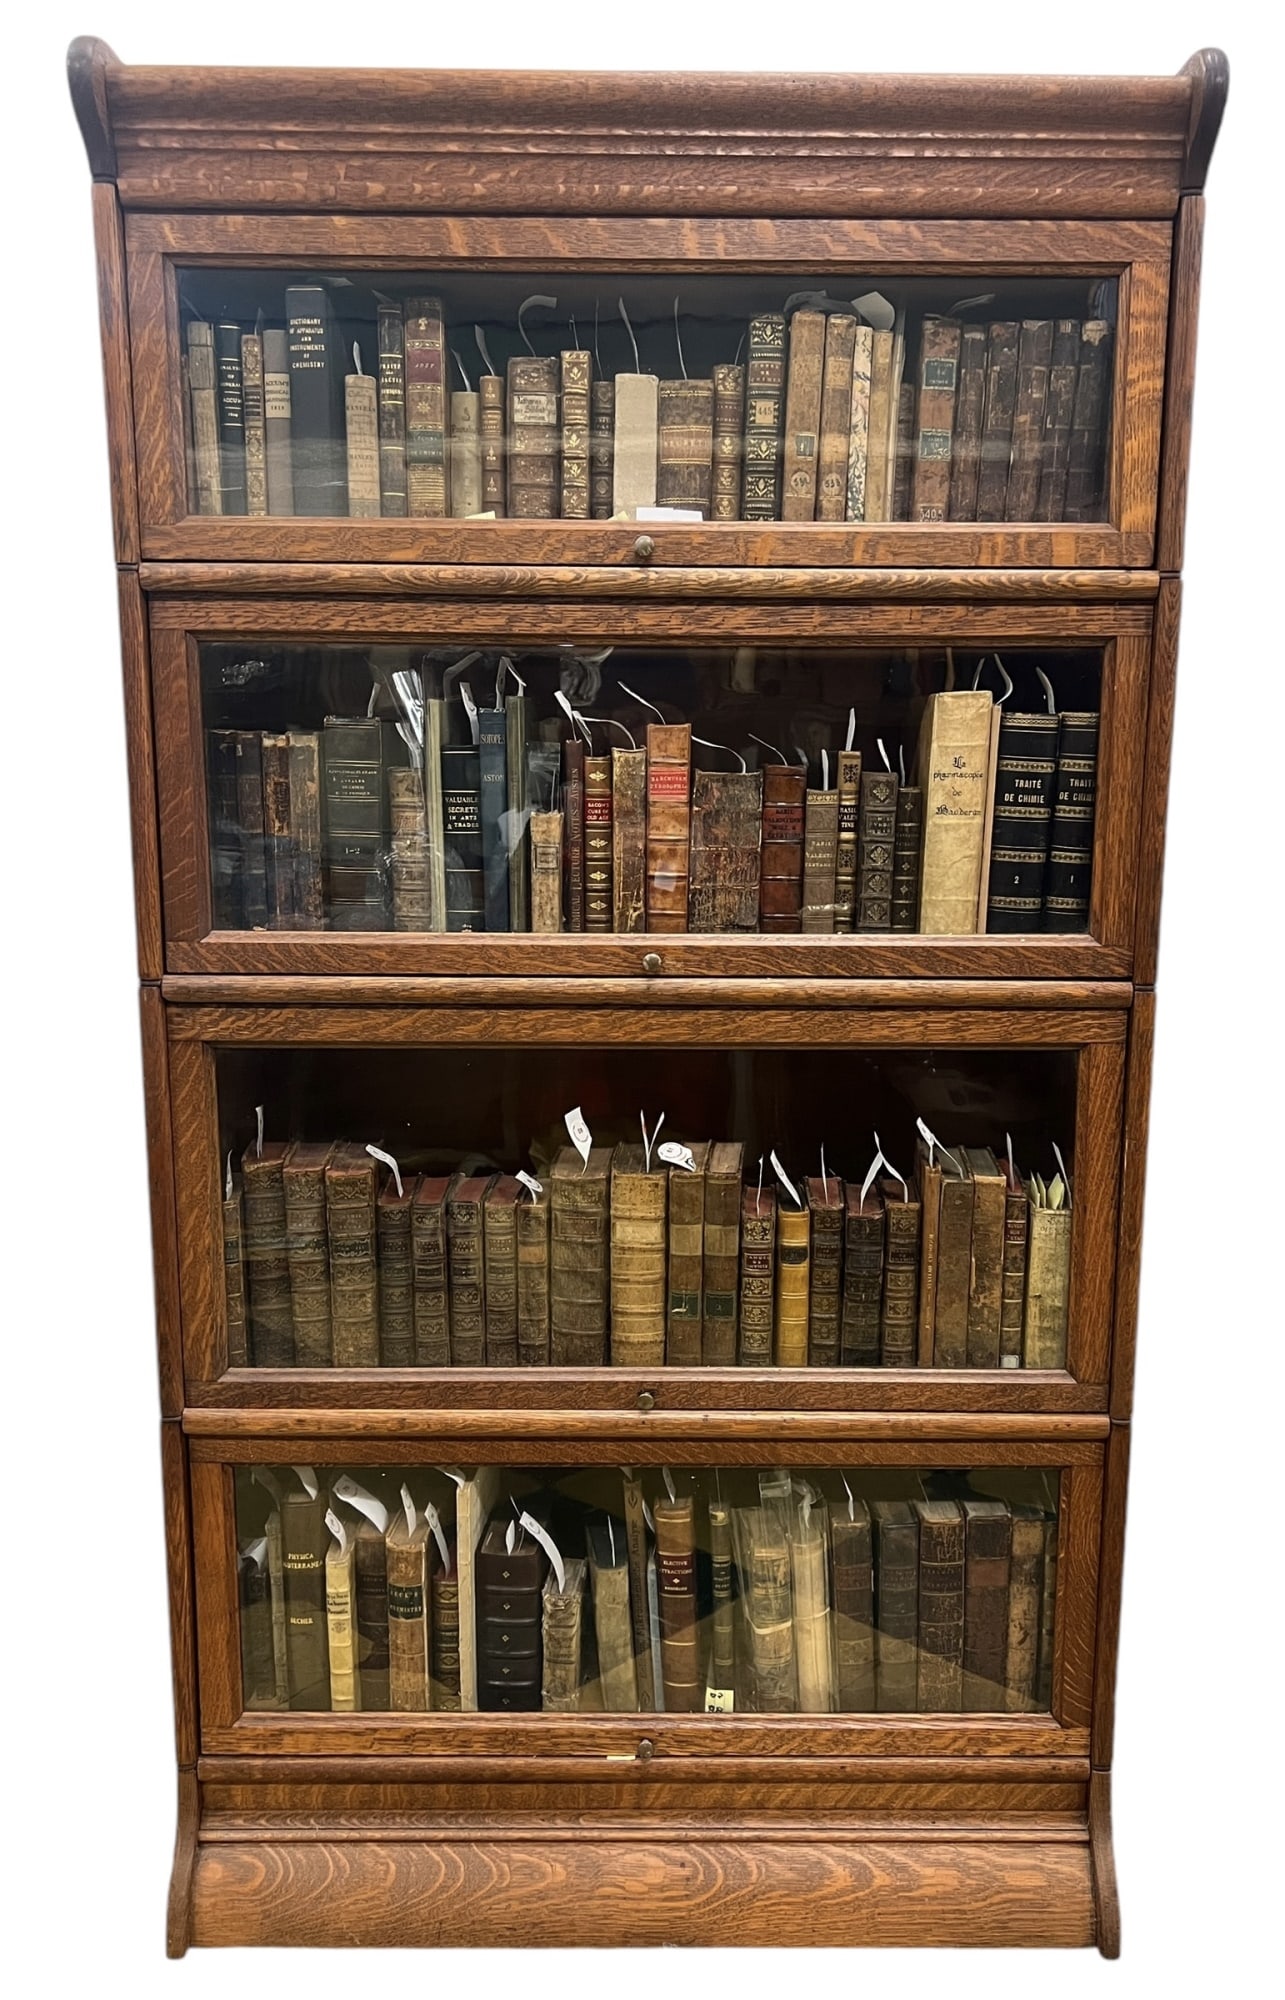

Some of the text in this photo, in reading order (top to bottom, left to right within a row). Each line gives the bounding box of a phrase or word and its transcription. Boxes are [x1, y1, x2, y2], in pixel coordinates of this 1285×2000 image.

[483, 774, 504, 782] ASTON
[1015, 779, 1042, 788] TRAITÉ
[1004, 793, 1045, 804] DE CHIMIE
[1058, 792, 1070, 800] DE
[570, 808, 582, 842] NOTES
[570, 847, 582, 890] LECTURE
[1014, 876, 1020, 884] 2
